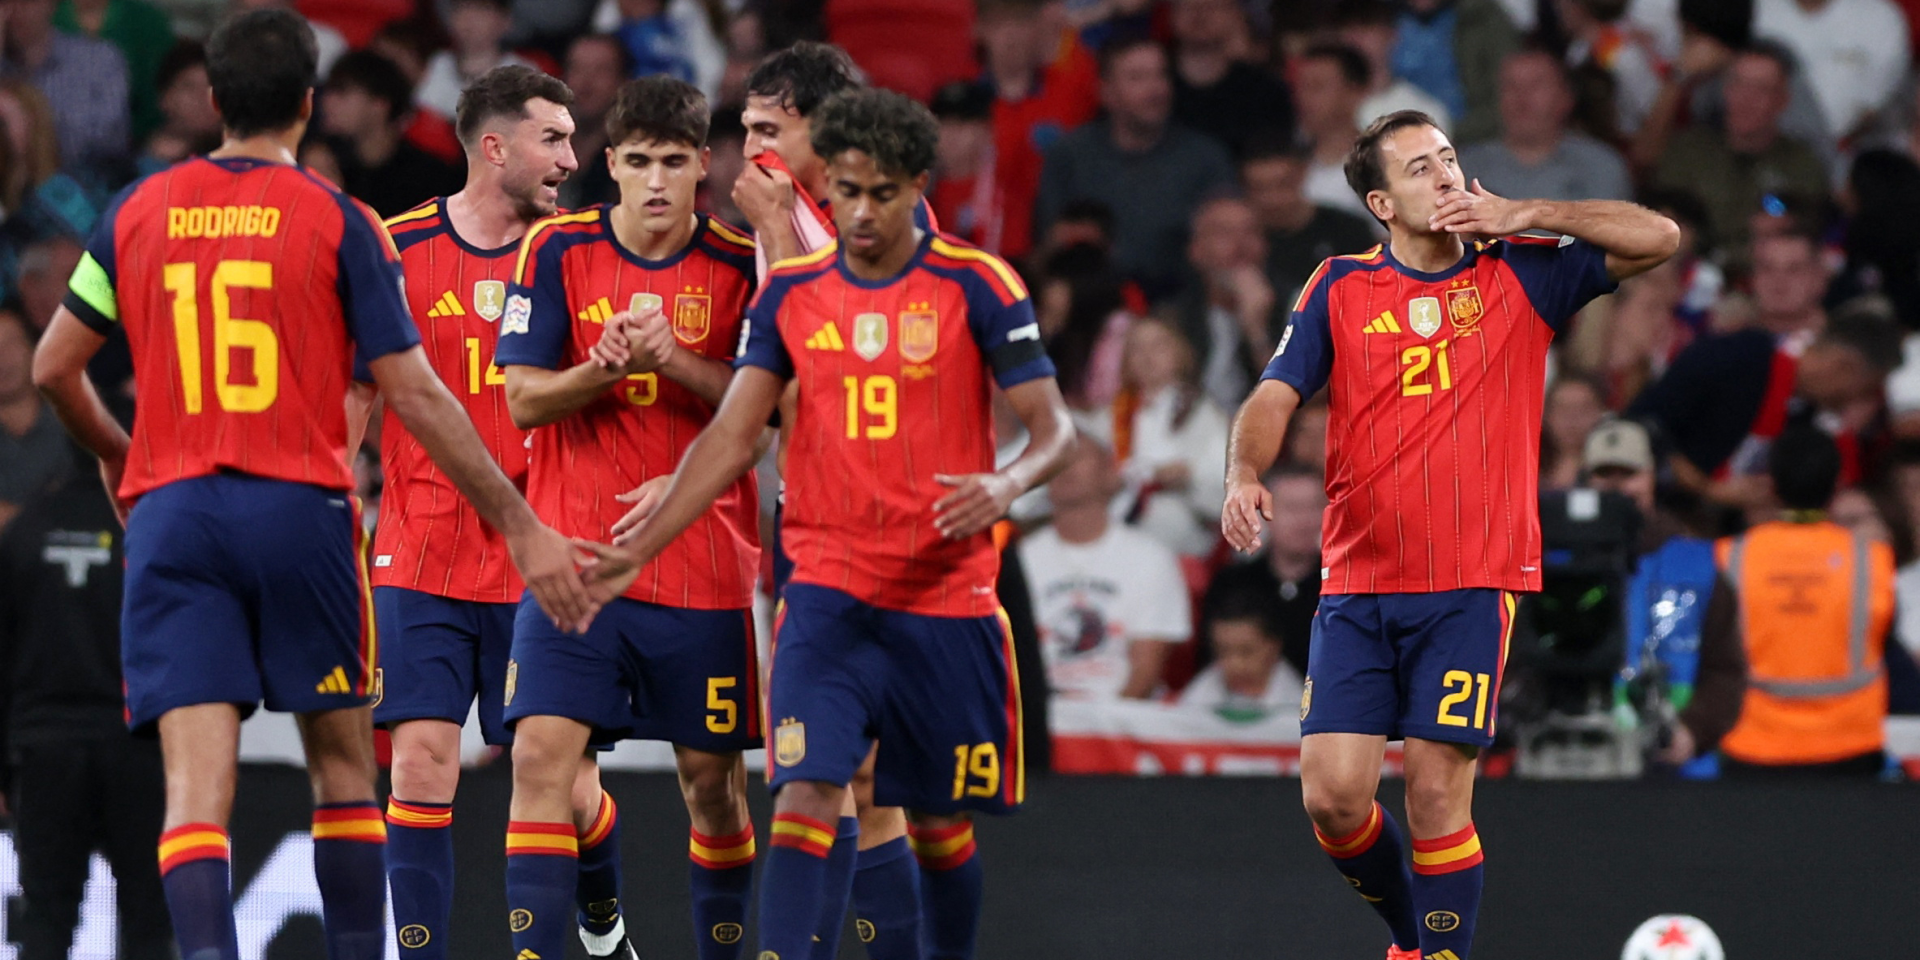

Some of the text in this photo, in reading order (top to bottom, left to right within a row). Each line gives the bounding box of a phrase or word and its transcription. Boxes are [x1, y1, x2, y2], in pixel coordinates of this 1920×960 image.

[168, 206, 281, 239] RODRIGO
[163, 260, 279, 414] 16
[1402, 338, 1452, 397] 21
[843, 375, 897, 439] 19
[705, 676, 737, 733] 5
[1437, 669, 1491, 730] 21
[952, 741, 1000, 800] 19
